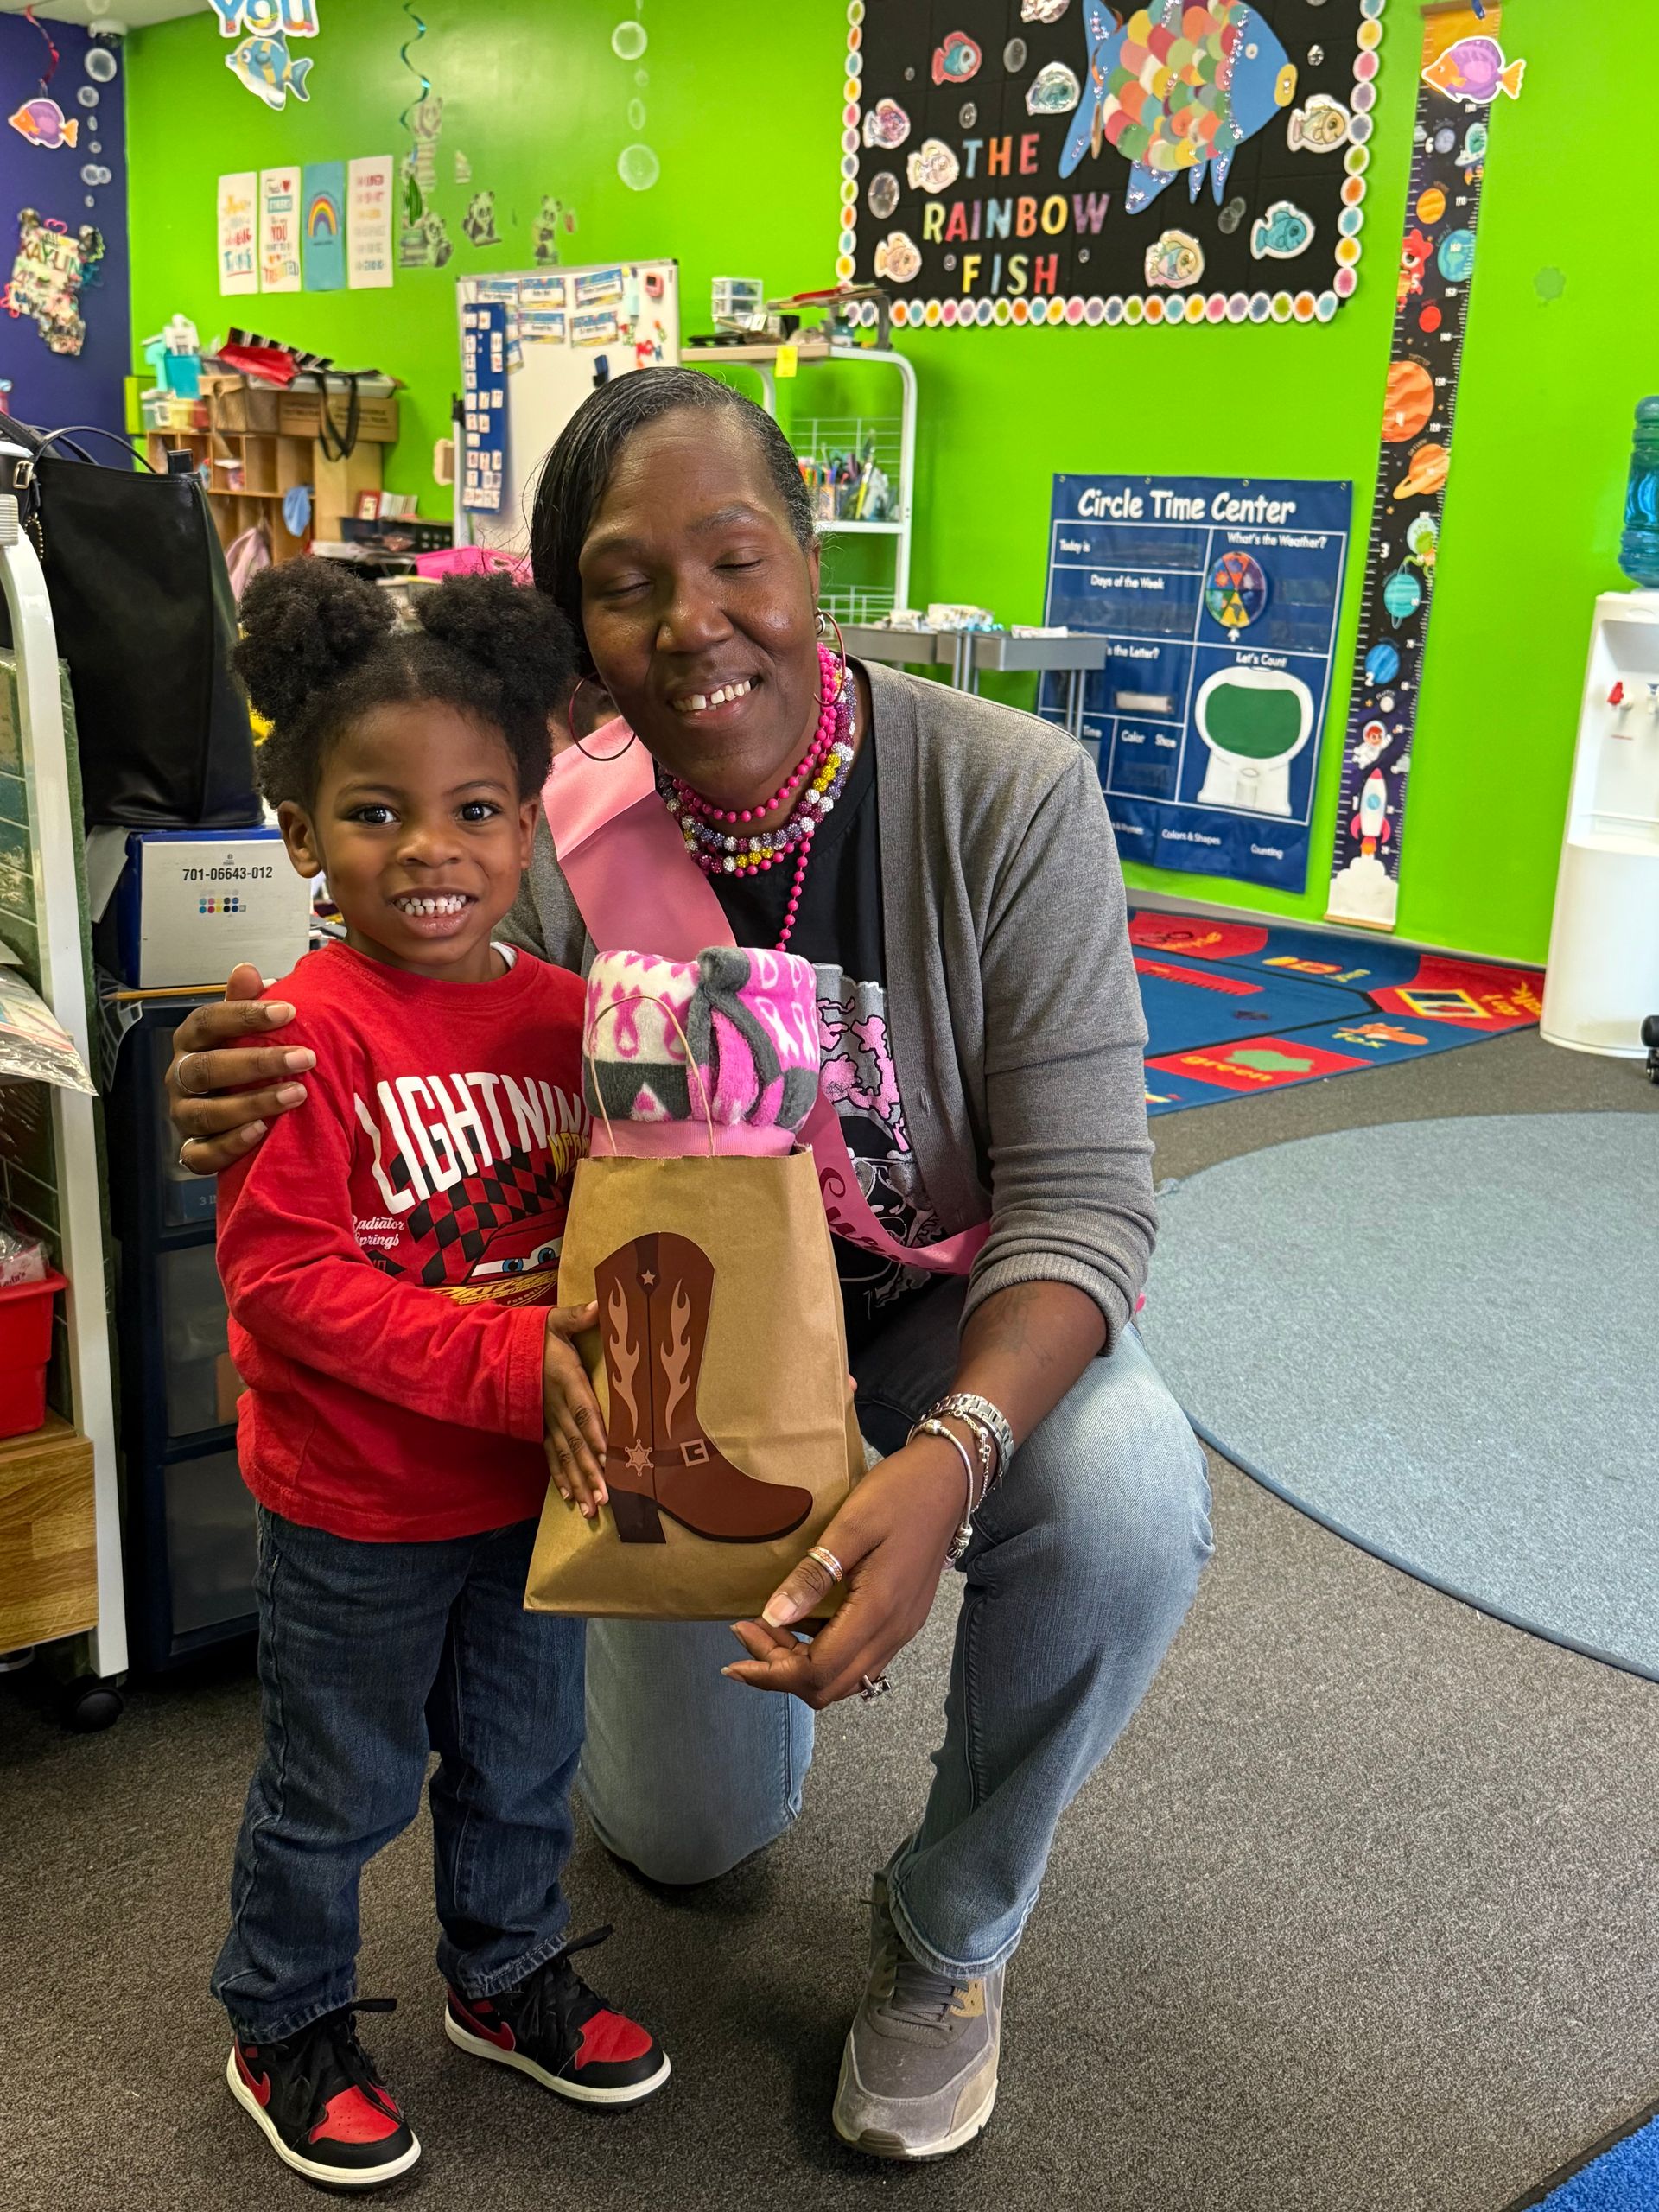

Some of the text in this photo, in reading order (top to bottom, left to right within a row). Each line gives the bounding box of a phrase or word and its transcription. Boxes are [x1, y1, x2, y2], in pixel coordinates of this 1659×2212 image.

[962, 133, 1040, 179] THE
[923, 192, 1112, 243] RAINBOW
[963, 254, 1058, 295] FISH
[1077, 487, 1297, 524] Circle Time Center
[1262, 533, 1277, 546] the
[1279, 534, 1328, 549] Weather?
[1090, 574, 1112, 589] Days
[1124, 576, 1139, 588] the
[1162, 828, 1187, 842] Colors
[1194, 832, 1221, 845] Shapes
[182, 866, 273, 881] 701-06643-012
[1180, 1055, 1273, 1082] green
